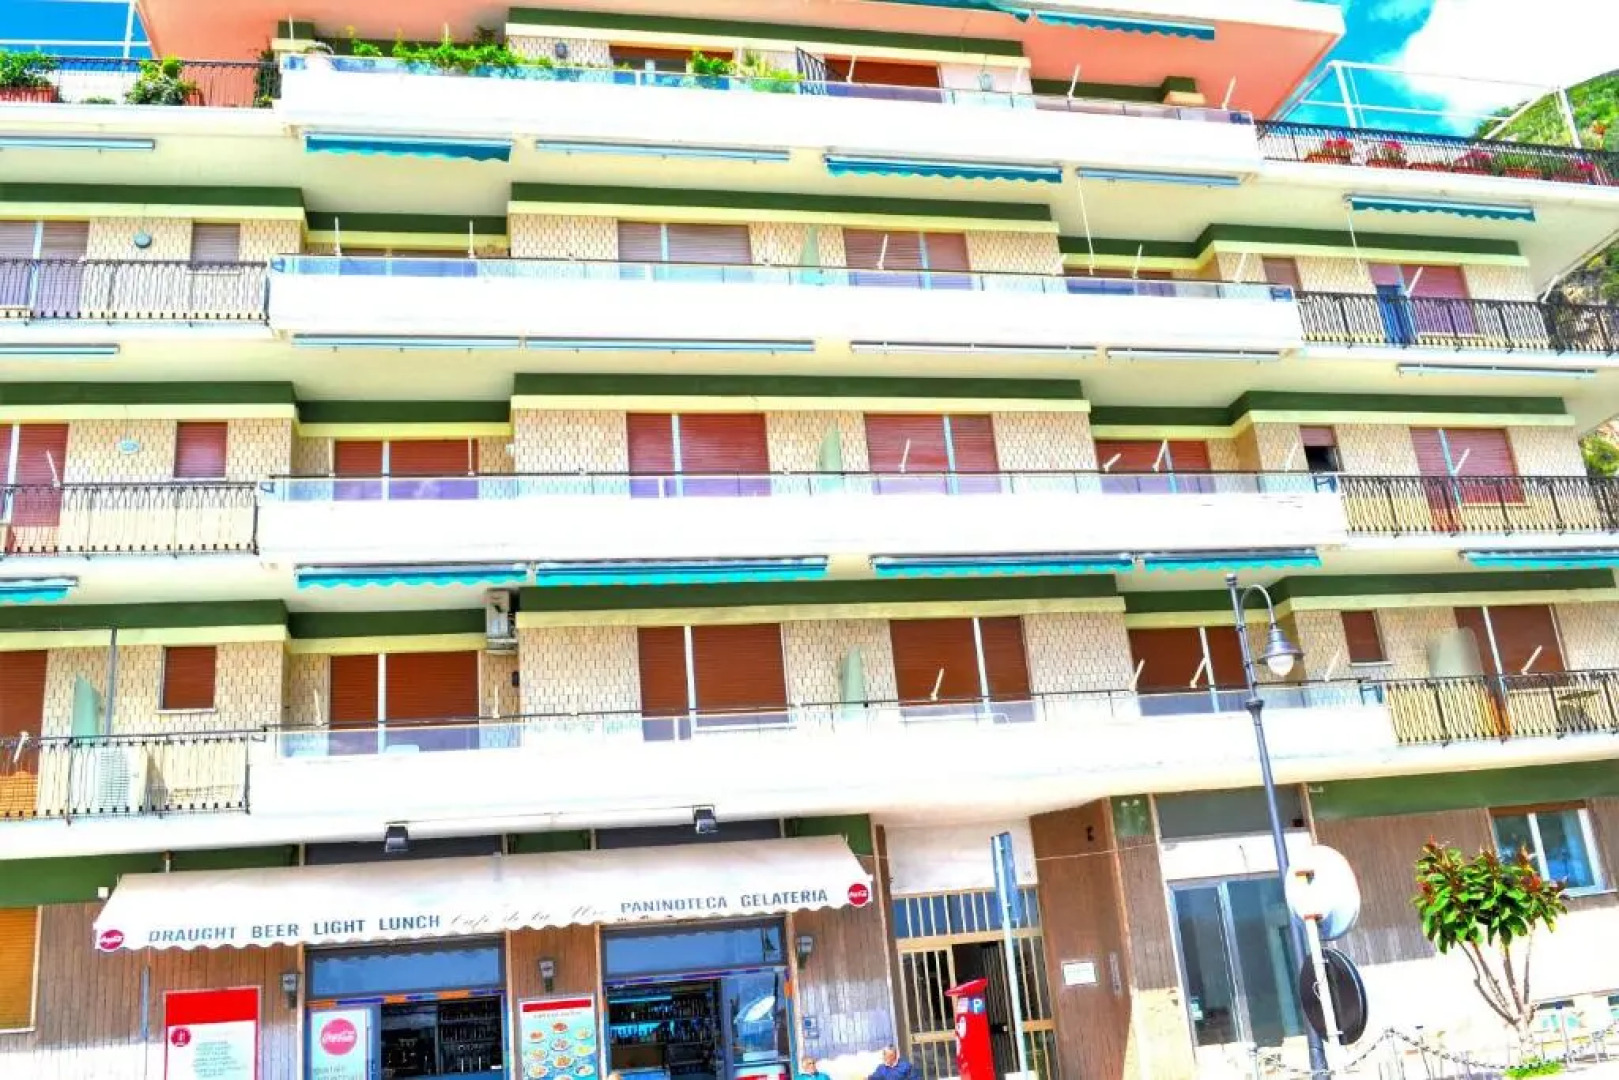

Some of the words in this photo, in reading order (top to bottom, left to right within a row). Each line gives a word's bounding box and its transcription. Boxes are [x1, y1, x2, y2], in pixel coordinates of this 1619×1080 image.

[620, 895, 728, 914] PANINOTECA
[740, 888, 829, 908] GELATERIA
[148, 926, 237, 943] DRAUGHT
[251, 923, 300, 939] BEER
[312, 919, 366, 936] LIGHT
[378, 914, 441, 932] LUNCH
